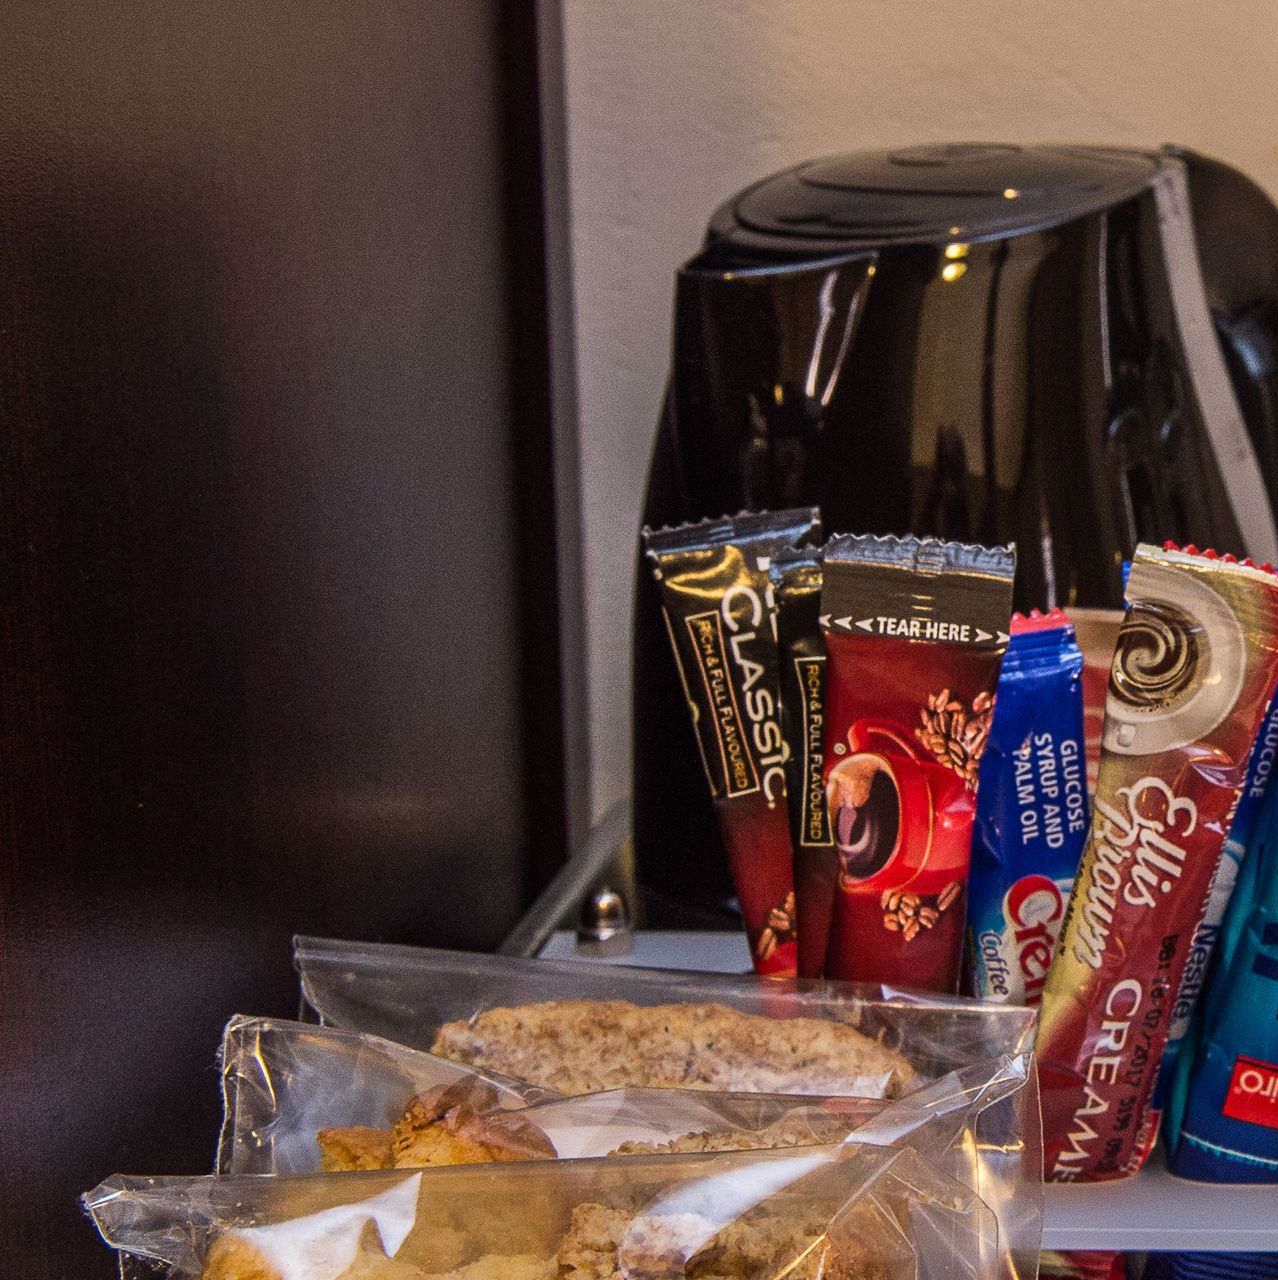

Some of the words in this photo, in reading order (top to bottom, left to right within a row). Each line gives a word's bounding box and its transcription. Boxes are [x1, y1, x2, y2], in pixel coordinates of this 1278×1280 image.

[698, 620, 713, 655] RICH
[876, 616, 920, 637] TEAR
[924, 621, 971, 642] HERE
[711, 668, 729, 706] FULL
[806, 663, 820, 699] RICH
[717, 706, 749, 788] FLAVOURED
[809, 713, 823, 750] FULL
[1012, 748, 1036, 805] PALM
[1034, 732, 1059, 798] SYRUP
[1060, 739, 1085, 833] GLUCOSE
[809, 751, 824, 839] FLAVOURED
[1020, 809, 1039, 845] OIL
[1043, 804, 1065, 849] AND
[1115, 776, 1198, 908] Ellis
[1073, 794, 1139, 969] Brown
[979, 931, 1010, 996] Coffee
